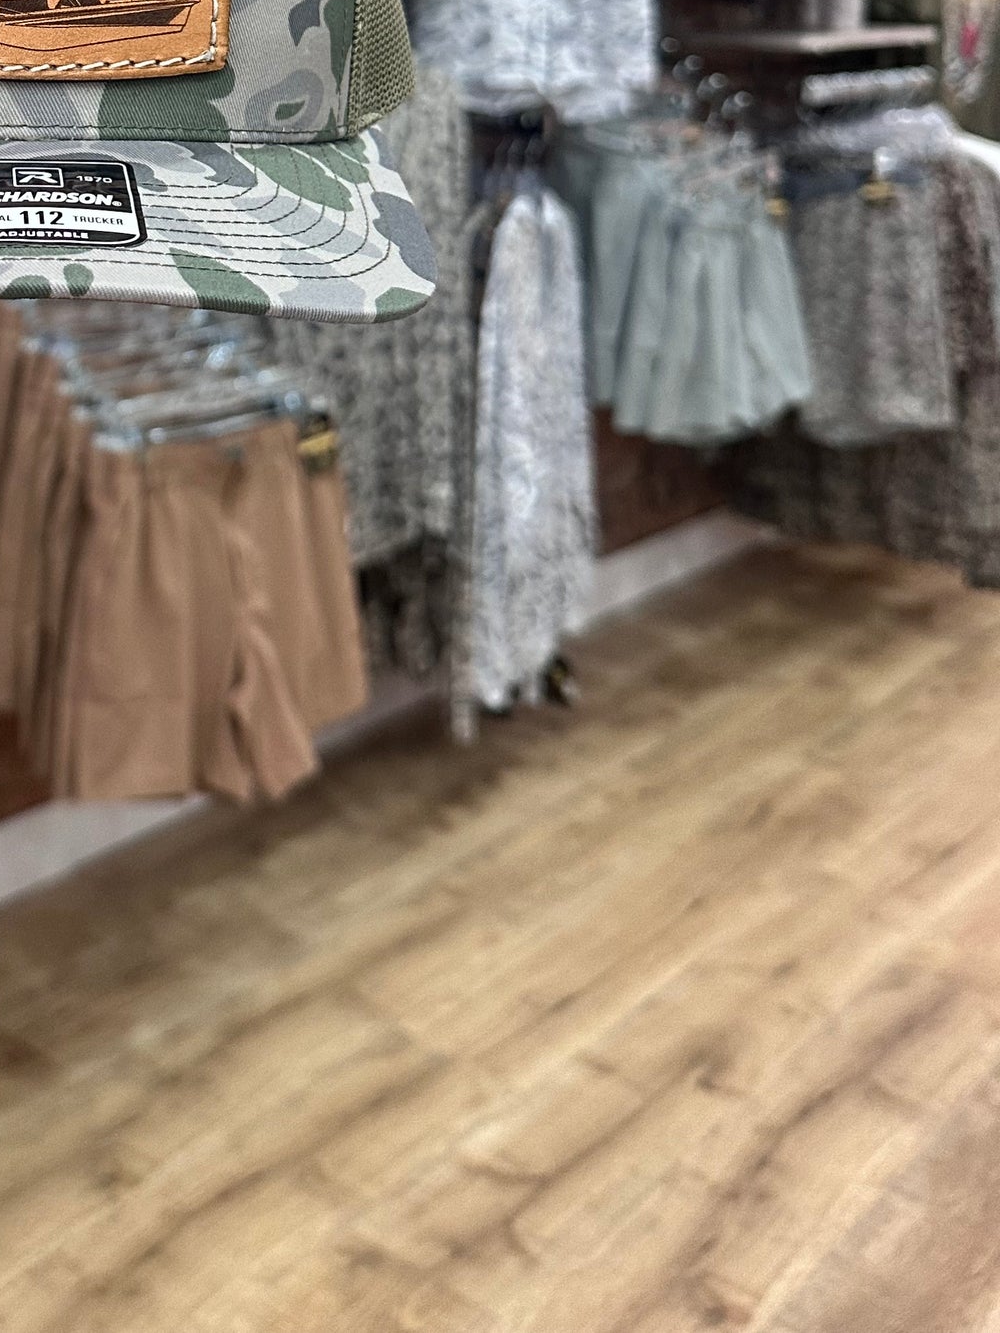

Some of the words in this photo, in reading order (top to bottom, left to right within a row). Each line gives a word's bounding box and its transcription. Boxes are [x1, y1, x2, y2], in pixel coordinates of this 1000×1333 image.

[76, 174, 113, 184] 1970
[19, 210, 65, 225] 112
[73, 215, 124, 226] TRUCKER
